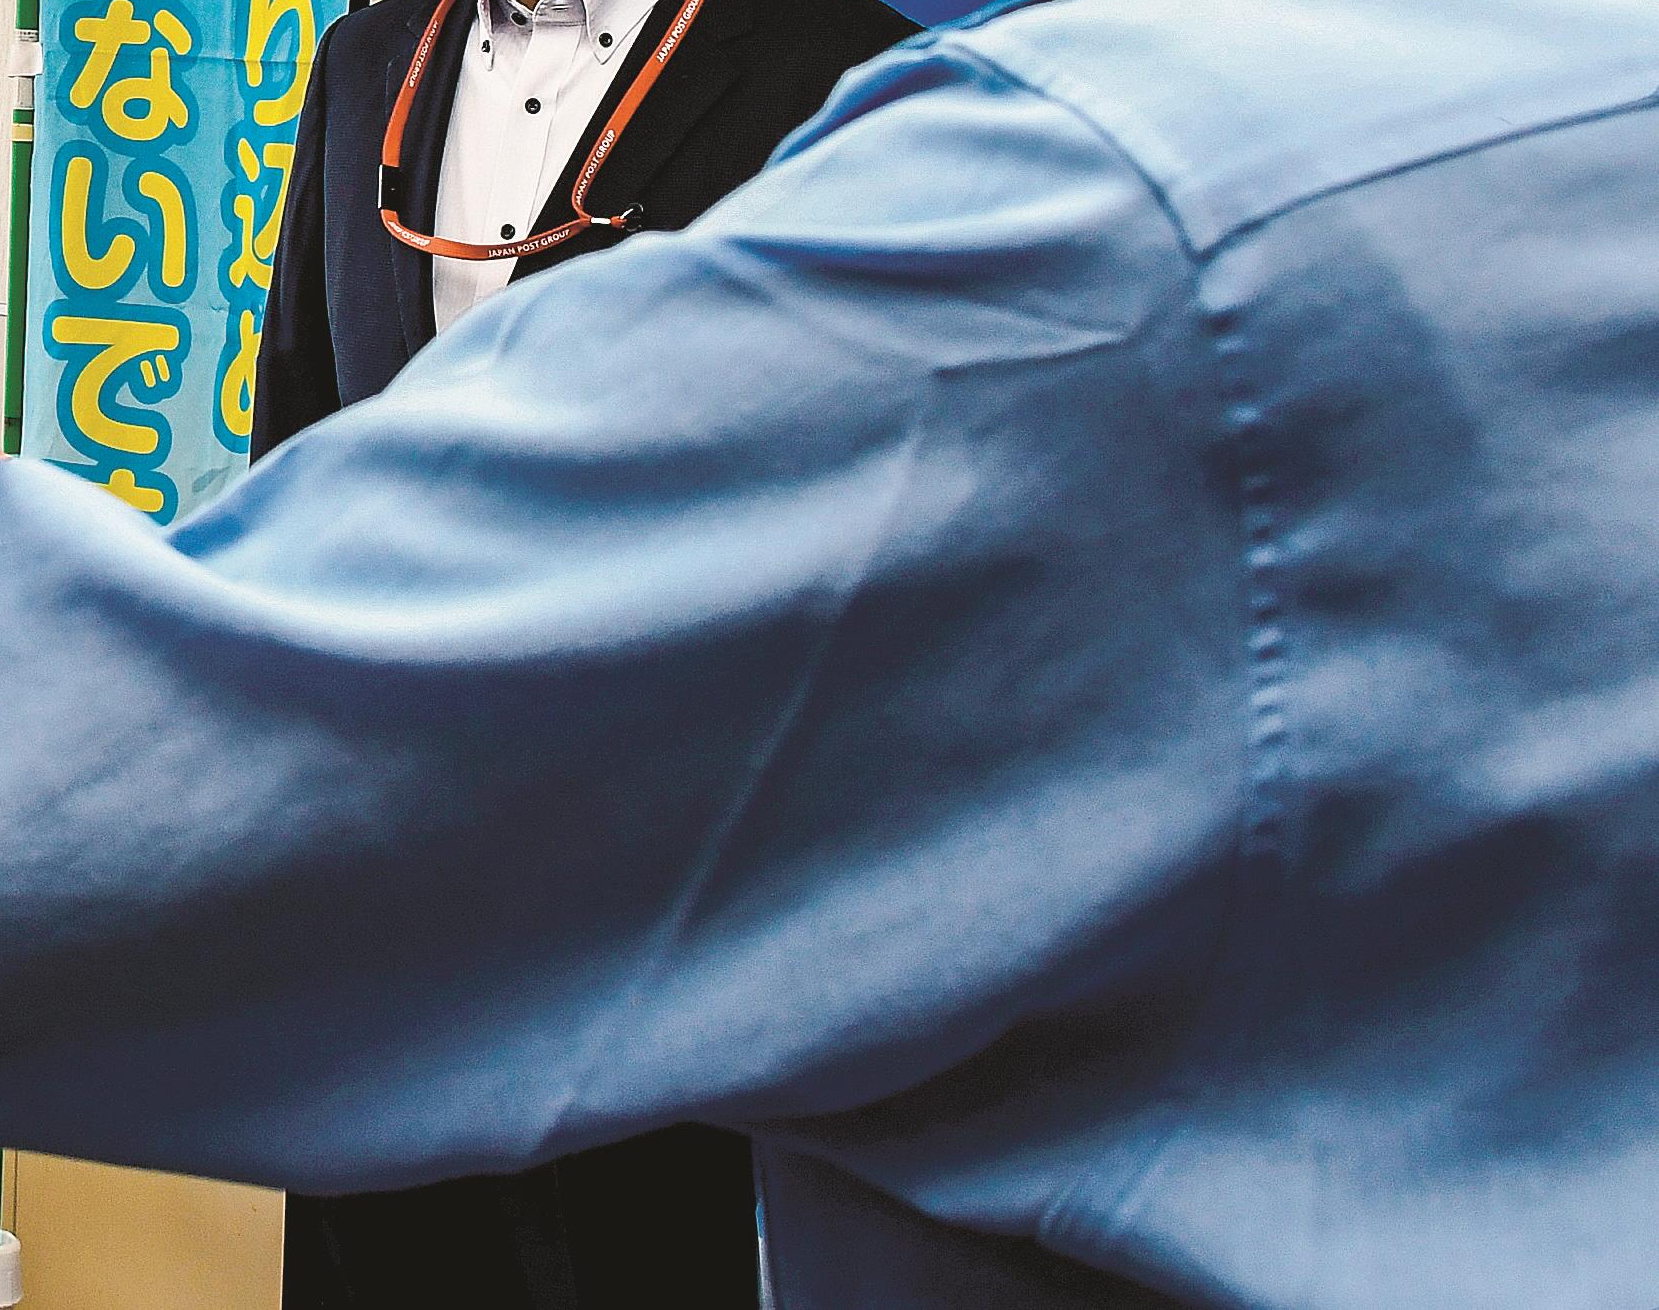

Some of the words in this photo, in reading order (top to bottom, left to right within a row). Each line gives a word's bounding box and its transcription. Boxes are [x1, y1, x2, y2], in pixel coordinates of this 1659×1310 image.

[656, 36, 677, 63] JAPAN
[671, 17, 688, 39] POST
[584, 156, 600, 179] POST
[595, 129, 616, 158] GROUP
[488, 246, 516, 258] JAPAN
[517, 240, 540, 253] POST
[540, 228, 570, 246] GROUP
